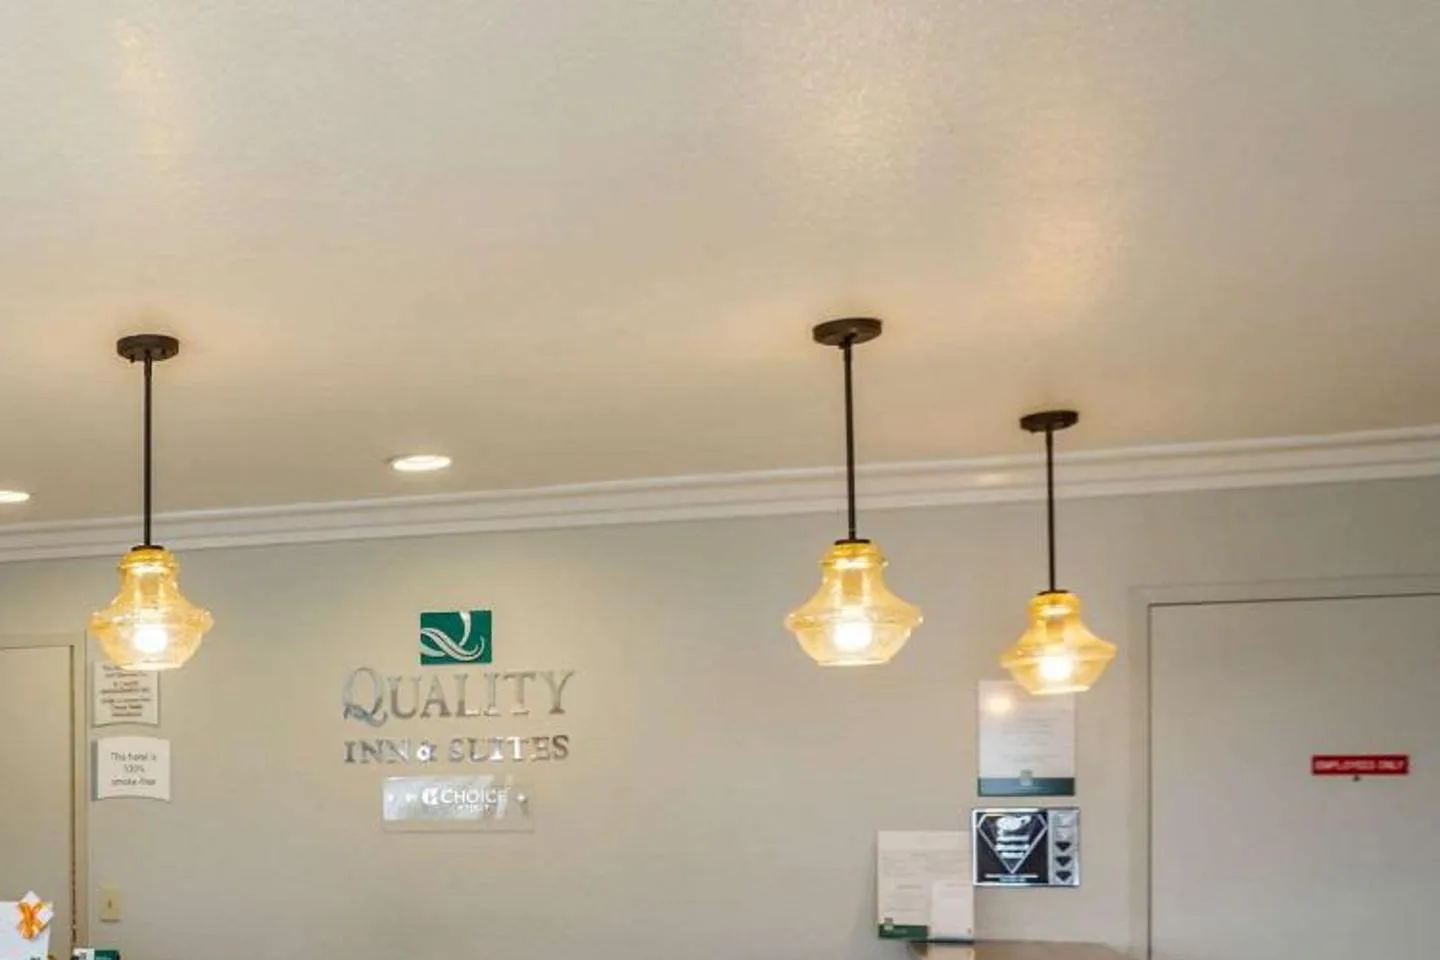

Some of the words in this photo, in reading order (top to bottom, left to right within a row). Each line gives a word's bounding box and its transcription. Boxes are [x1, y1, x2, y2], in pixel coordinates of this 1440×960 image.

[342, 667, 575, 727] QUALITY
[344, 738, 410, 764] INN
[417, 738, 437, 761] &
[448, 734, 570, 763] SUITES
